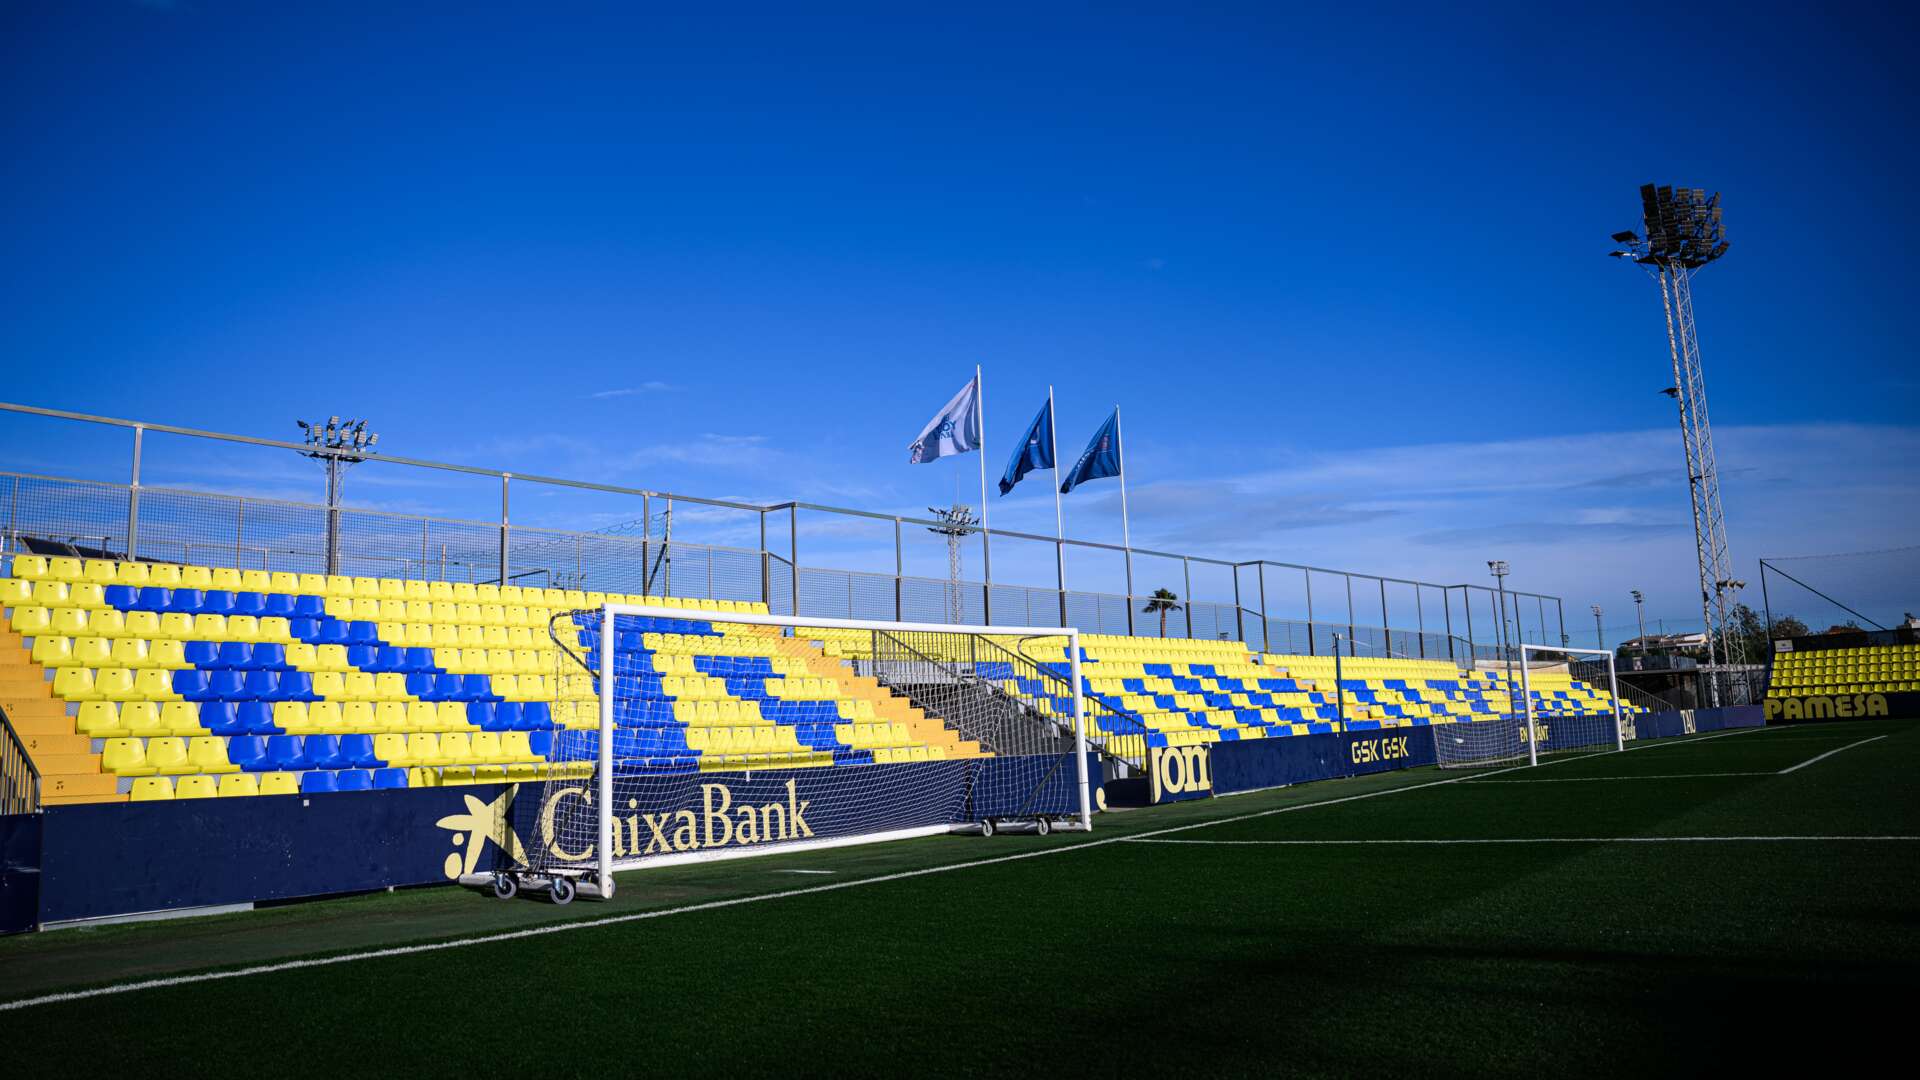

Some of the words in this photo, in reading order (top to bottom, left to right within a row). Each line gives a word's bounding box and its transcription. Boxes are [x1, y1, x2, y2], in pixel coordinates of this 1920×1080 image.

[1763, 693, 1889, 720] PAMESA
[1352, 739, 1380, 764] GSK
[1382, 736, 1409, 760] GSK
[541, 778, 814, 862] CaixaBank
